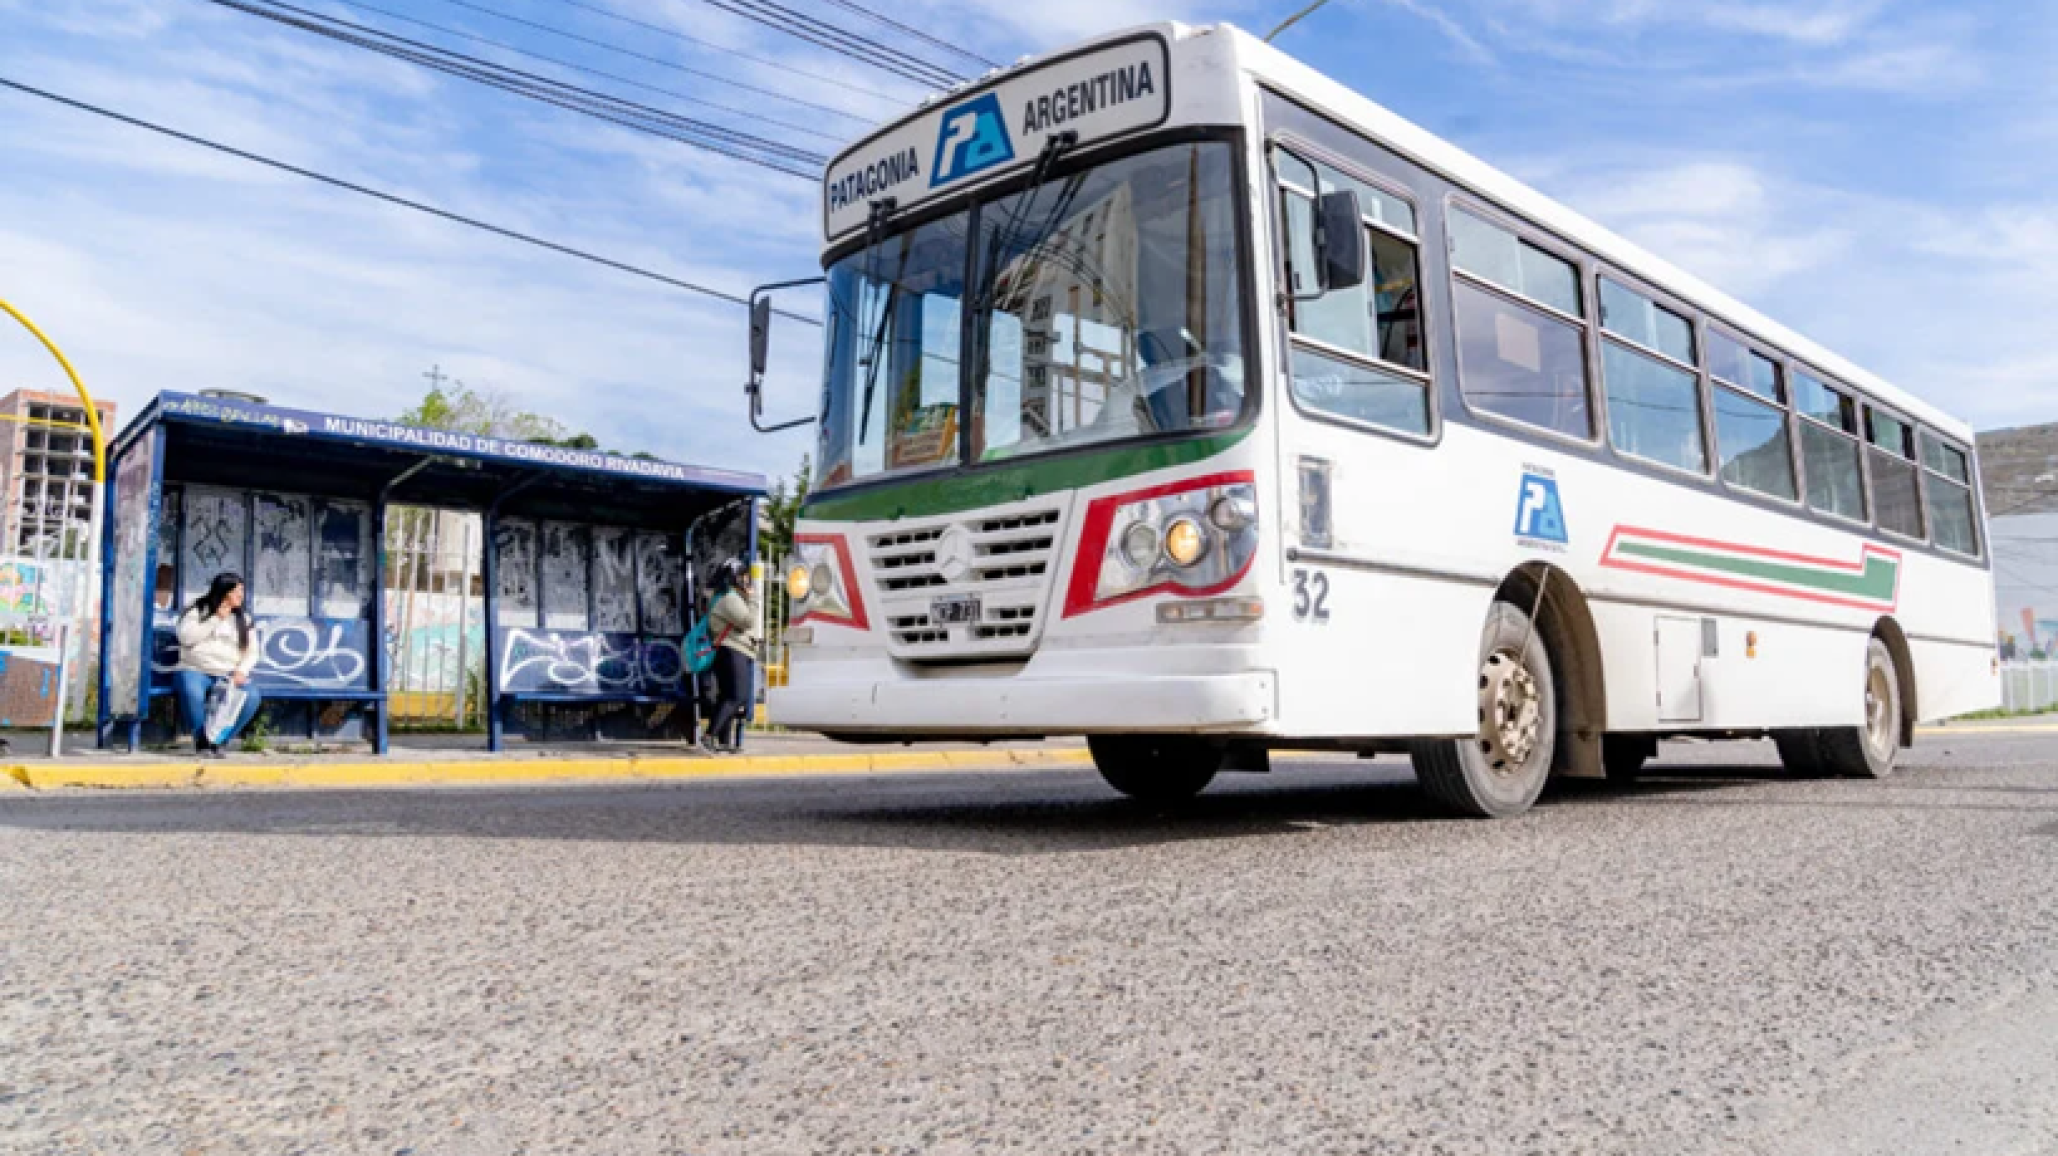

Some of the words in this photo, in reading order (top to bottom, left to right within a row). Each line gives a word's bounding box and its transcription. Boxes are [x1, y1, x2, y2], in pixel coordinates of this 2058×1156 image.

[831, 146, 920, 214] PATAGONIA
[1023, 60, 1154, 136] ARGENTINA
[324, 416, 471, 449] MUNICIPALIDAD
[475, 439, 498, 453] DE
[504, 442, 600, 468] COMODORO
[606, 456, 685, 480] RIVADAVIA
[1292, 568, 1331, 620] 32
